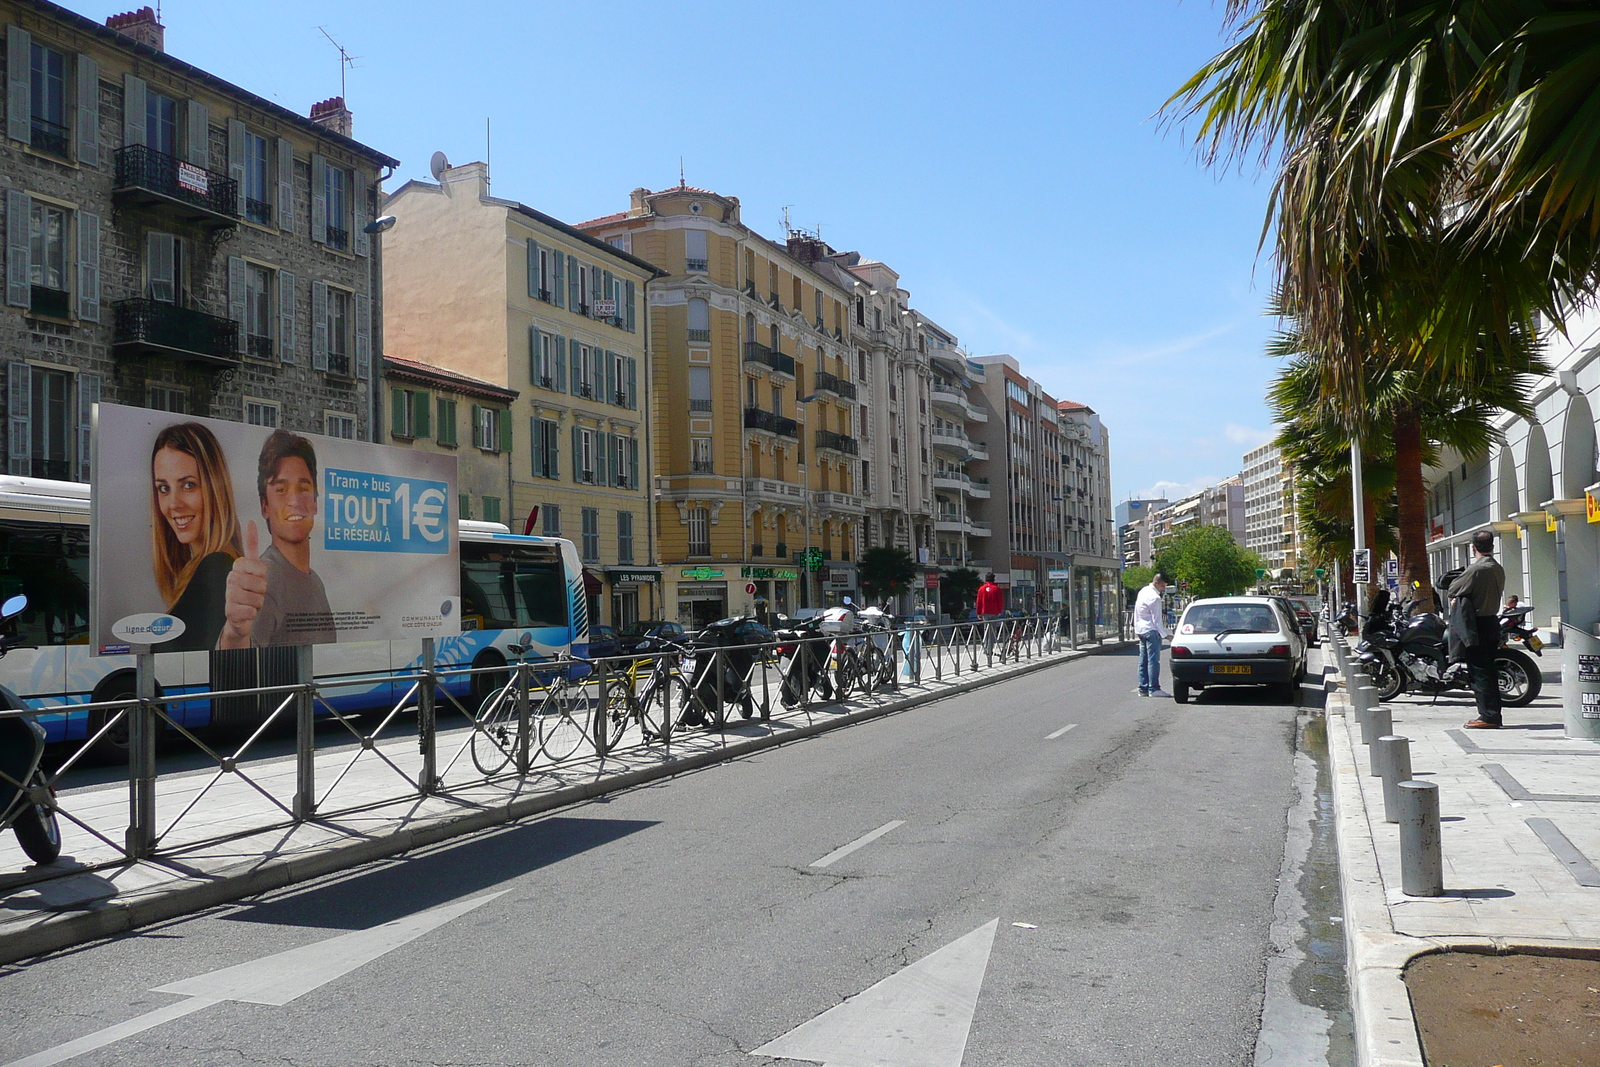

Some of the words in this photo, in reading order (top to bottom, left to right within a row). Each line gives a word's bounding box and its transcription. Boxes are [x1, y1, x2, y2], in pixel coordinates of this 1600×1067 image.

[185, 163, 206, 177] VENDRE
[329, 472, 359, 489] Tram
[371, 477, 391, 493] bus
[328, 493, 392, 526] TOUT
[327, 527, 341, 540] LE
[343, 525, 382, 542] RÉSEAU
[384, 527, 392, 543] À
[1389, 561, 1397, 572] P
[620, 574, 630, 582] LES
[631, 574, 656, 582] PYRAMIDES
[125, 626, 145, 635] ligne
[1241, 665, 1250, 673] 06
[1582, 693, 1600, 705] RAP
